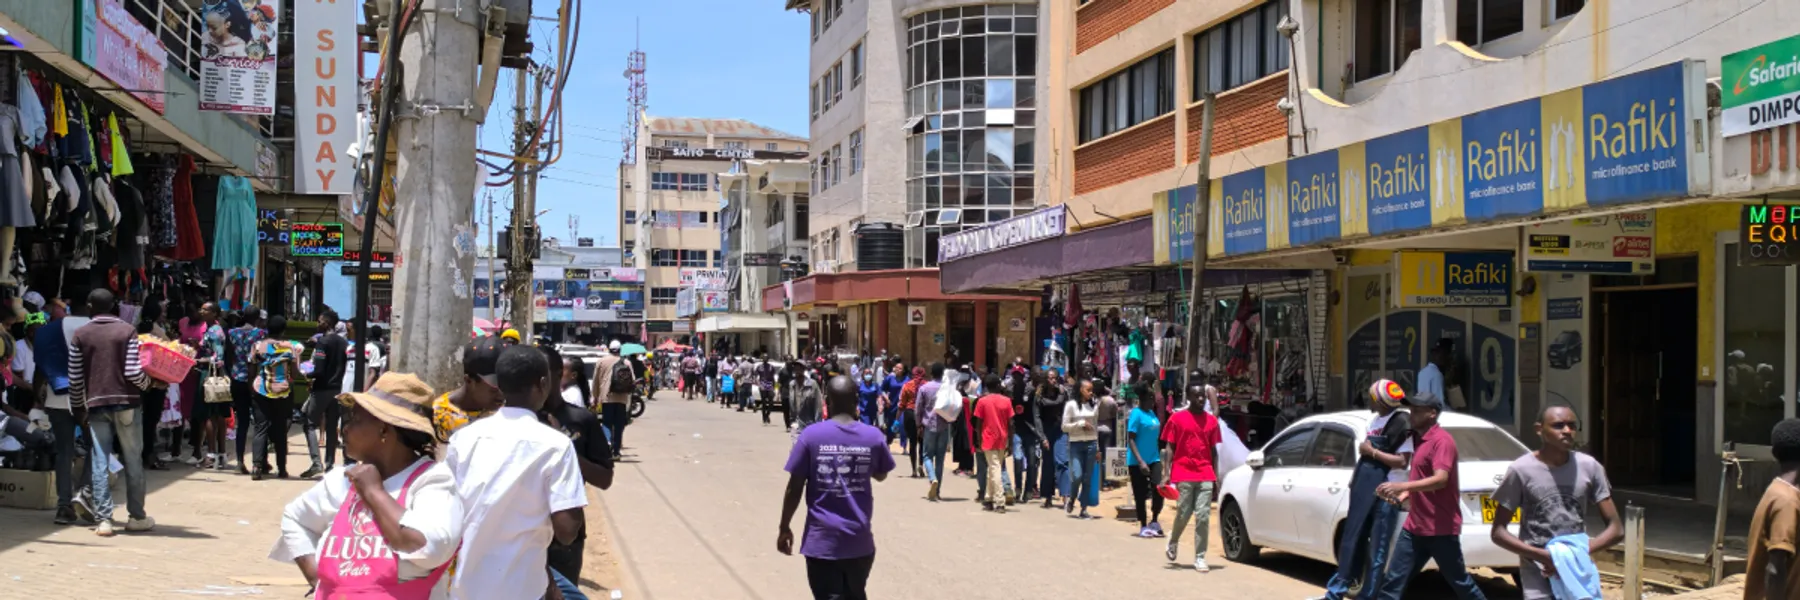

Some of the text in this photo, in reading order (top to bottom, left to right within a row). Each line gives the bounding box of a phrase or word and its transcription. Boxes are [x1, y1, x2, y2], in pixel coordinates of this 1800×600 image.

[216, 56, 262, 69] Services
[1749, 55, 1800, 86] Safari
[315, 29, 337, 191] SUNDAY
[1590, 98, 1676, 161] Rafiki
[673, 148, 704, 157] SAITO
[1468, 128, 1536, 183] Rafiki
[1370, 153, 1425, 200] Rafiki
[1592, 156, 1676, 179] microfinance bank
[1291, 172, 1336, 213] Rafiki
[1470, 181, 1536, 199] microfinance bank
[1225, 188, 1263, 225] Rafiki
[1627, 236, 1650, 248] airtel
[1448, 262, 1508, 284] Rafiki
[1416, 296, 1499, 306] Bureau De Change
[1480, 337, 1503, 410] 9
[839, 444, 871, 453] Sponsors
[324, 535, 394, 559] LUSH
[339, 560, 371, 576] Hair
